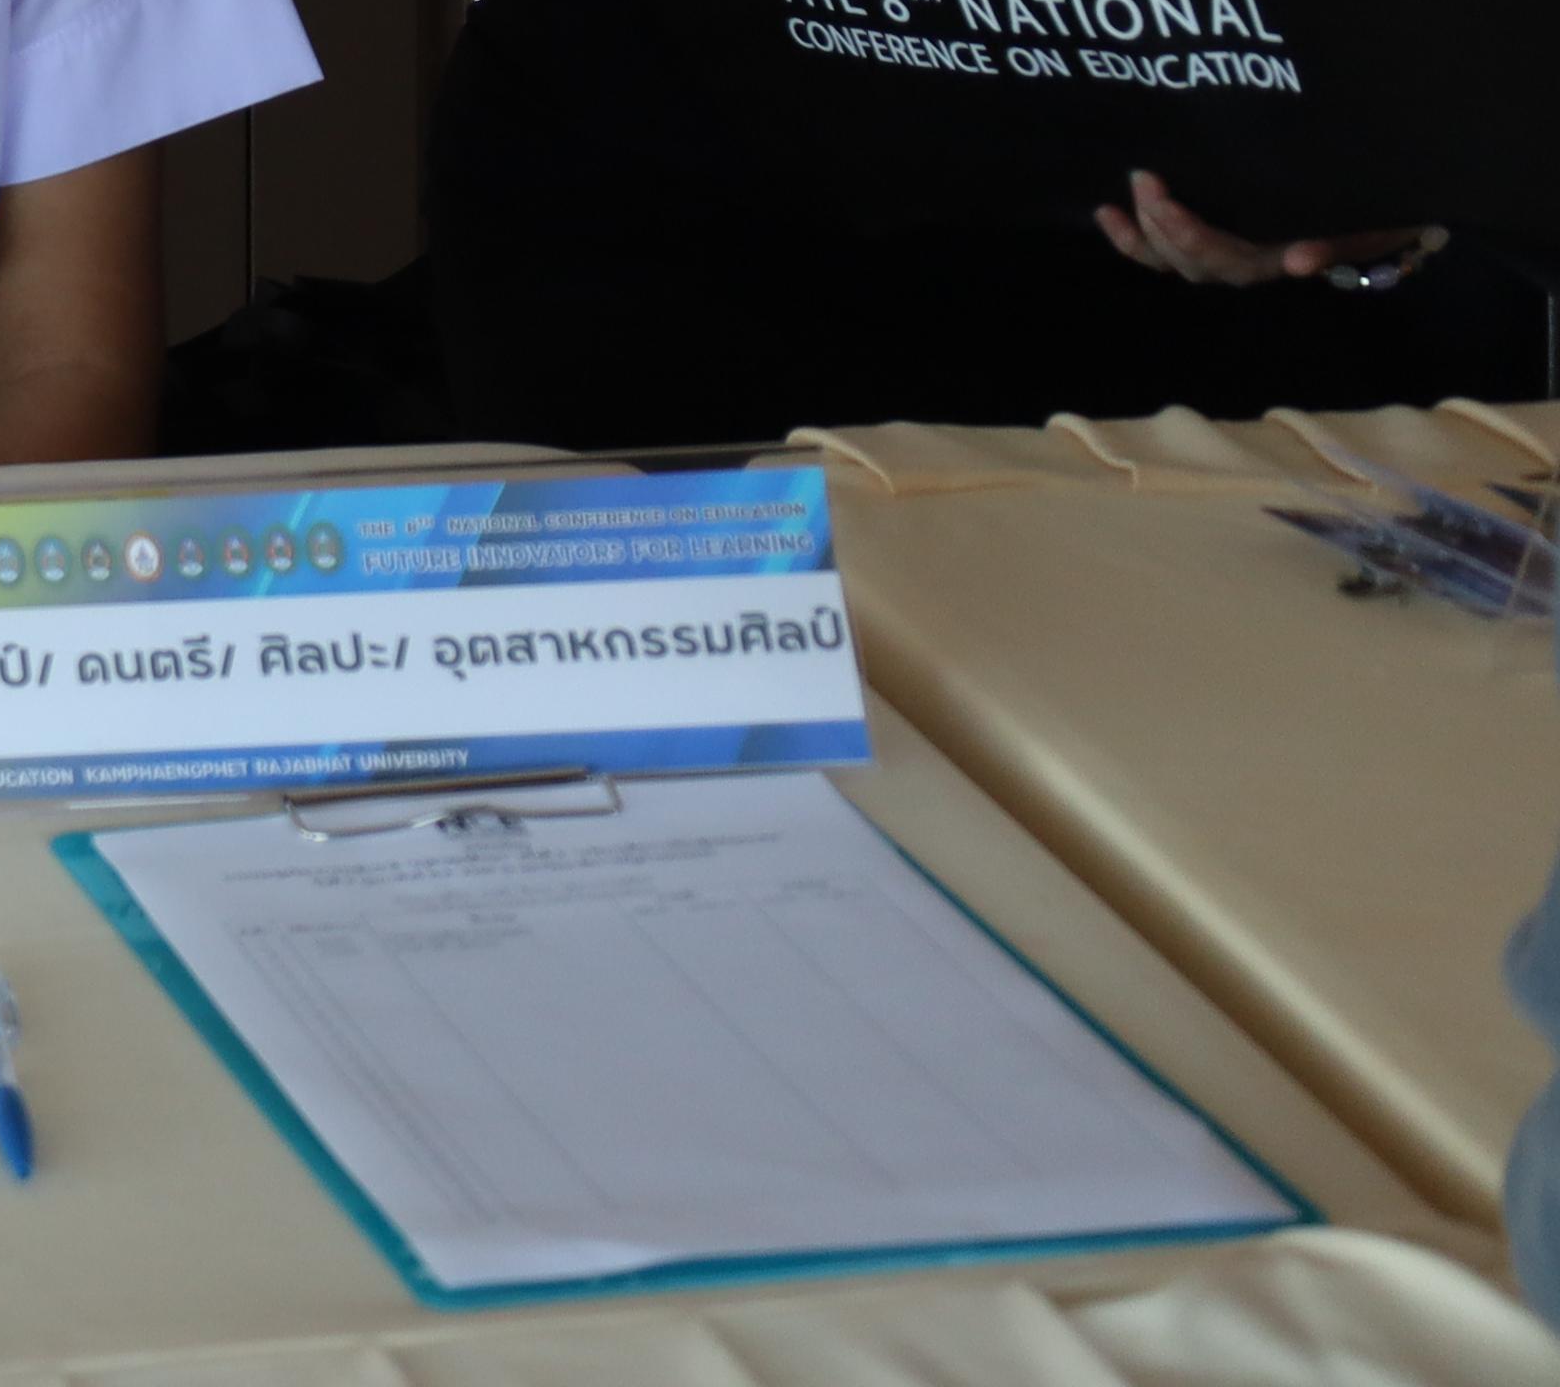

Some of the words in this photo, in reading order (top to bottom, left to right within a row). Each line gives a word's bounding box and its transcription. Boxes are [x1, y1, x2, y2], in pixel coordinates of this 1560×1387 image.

[788, 16, 998, 76] CONFERENCE
[1008, 45, 1072, 77] ON
[1085, 48, 1301, 93] EDUCATION
[690, 531, 815, 560] LEARNING
[76, 633, 235, 685] ดนตรี/
[259, 631, 410, 677] ศิลปะ/
[433, 605, 847, 681] อุตสาหกรรมศิลป์
[84, 759, 250, 784] KAMPHAENGPHET
[254, 753, 351, 779] RAJABHAT
[359, 747, 470, 771] UNIVERSITY
